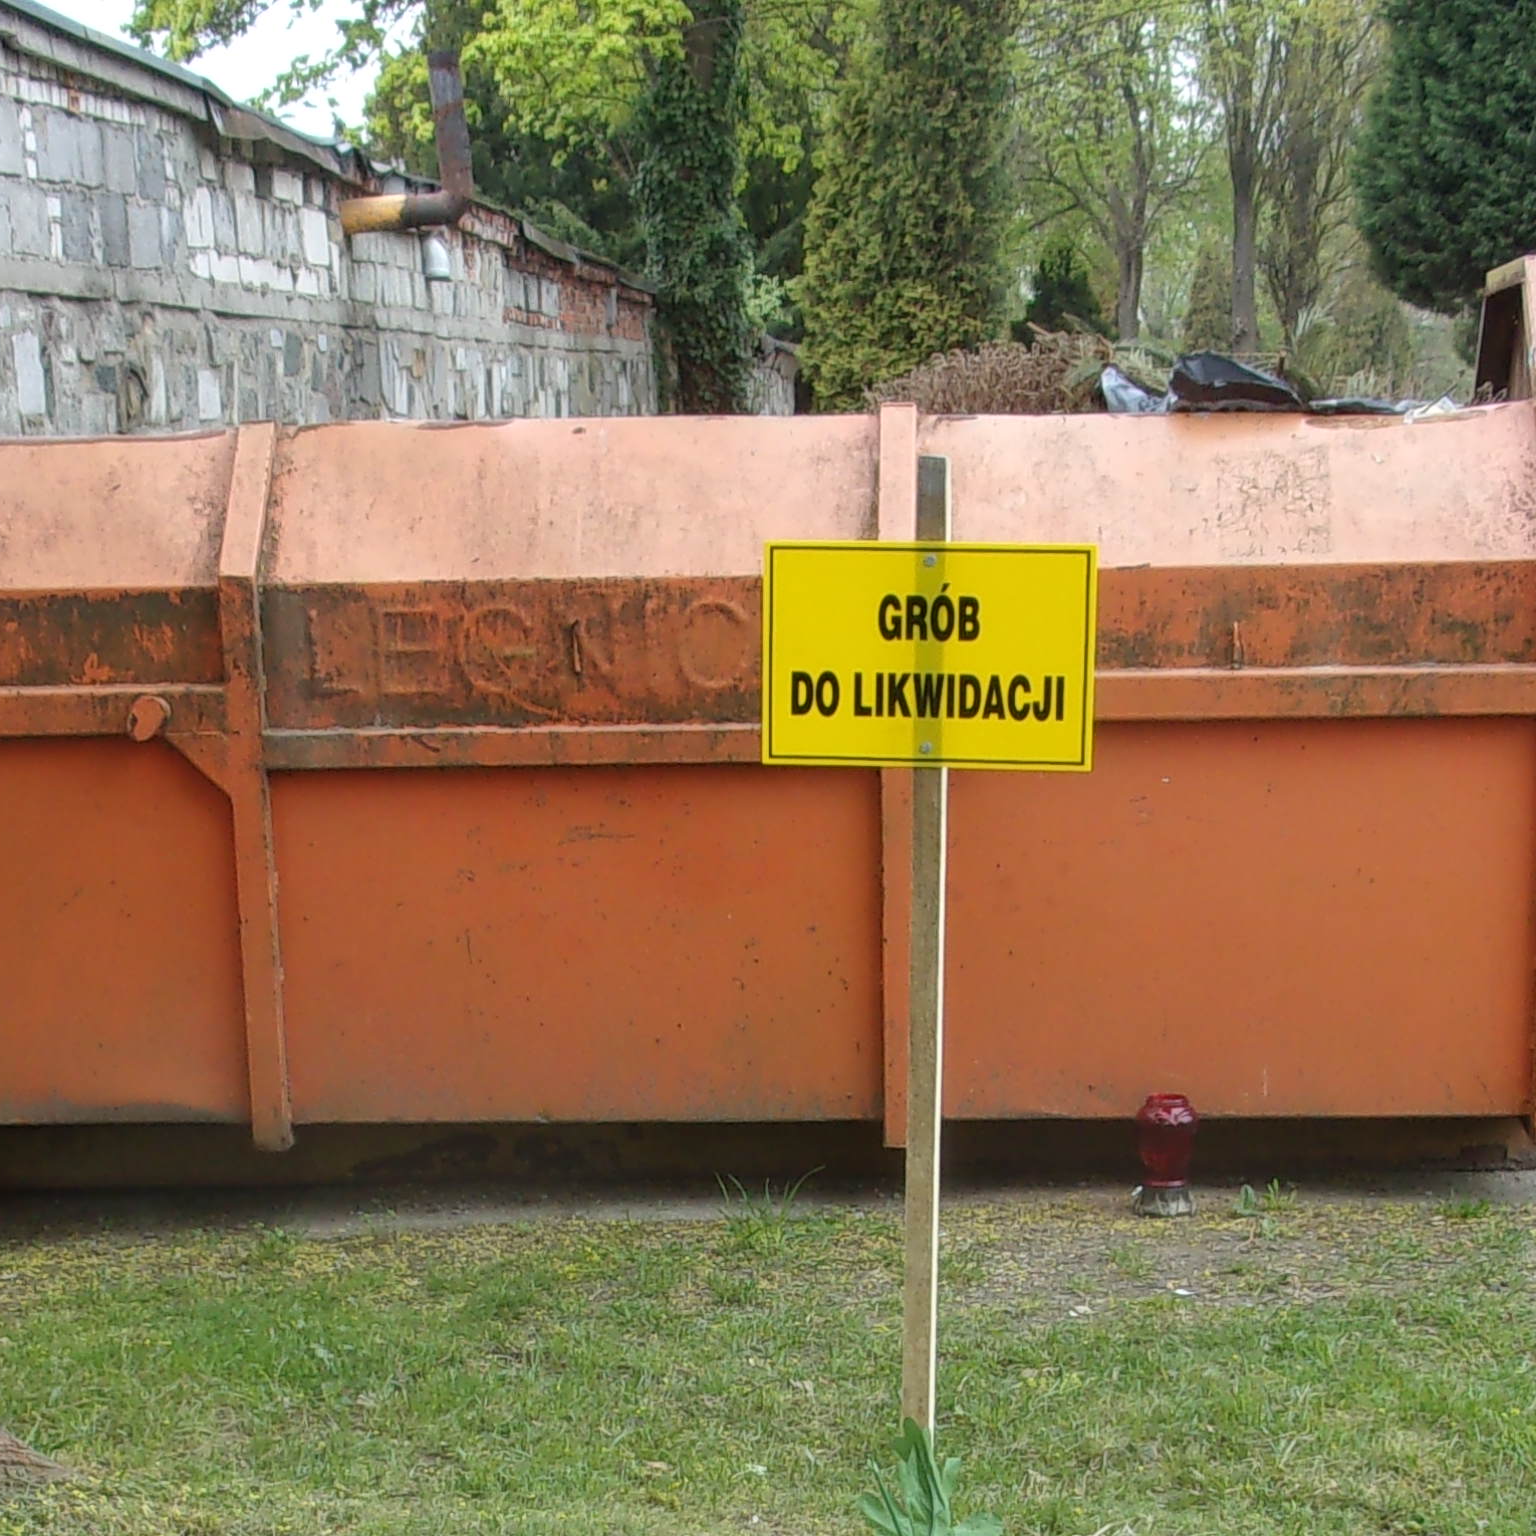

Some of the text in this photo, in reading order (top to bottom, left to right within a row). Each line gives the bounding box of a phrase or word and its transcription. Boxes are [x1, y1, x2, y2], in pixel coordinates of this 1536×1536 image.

[878, 583, 981, 642] GRÓB
[790, 670, 1066, 722] DO LIKWIDACJI
